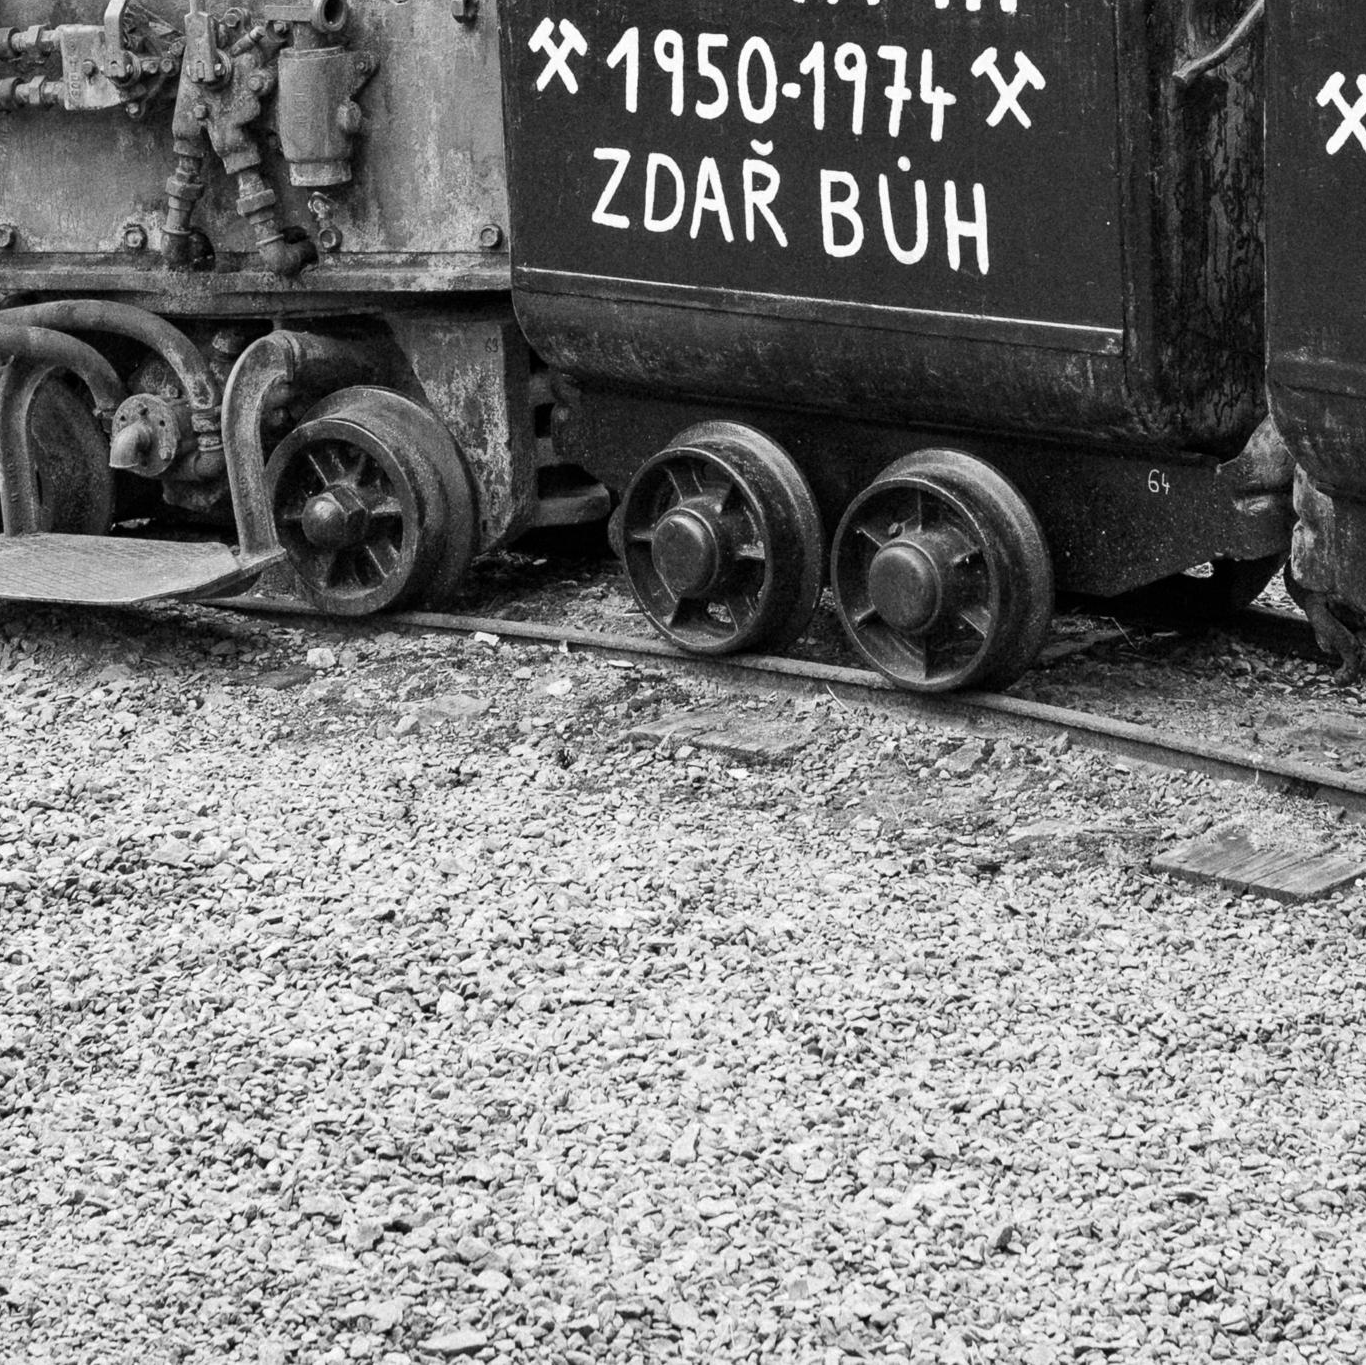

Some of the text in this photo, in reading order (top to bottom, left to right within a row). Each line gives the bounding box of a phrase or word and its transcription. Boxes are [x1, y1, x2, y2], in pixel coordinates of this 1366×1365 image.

[606, 26, 957, 142] 1950-1974
[591, 138, 990, 275] ZDAŘ BŮH
[1147, 468, 1171, 495] 64
